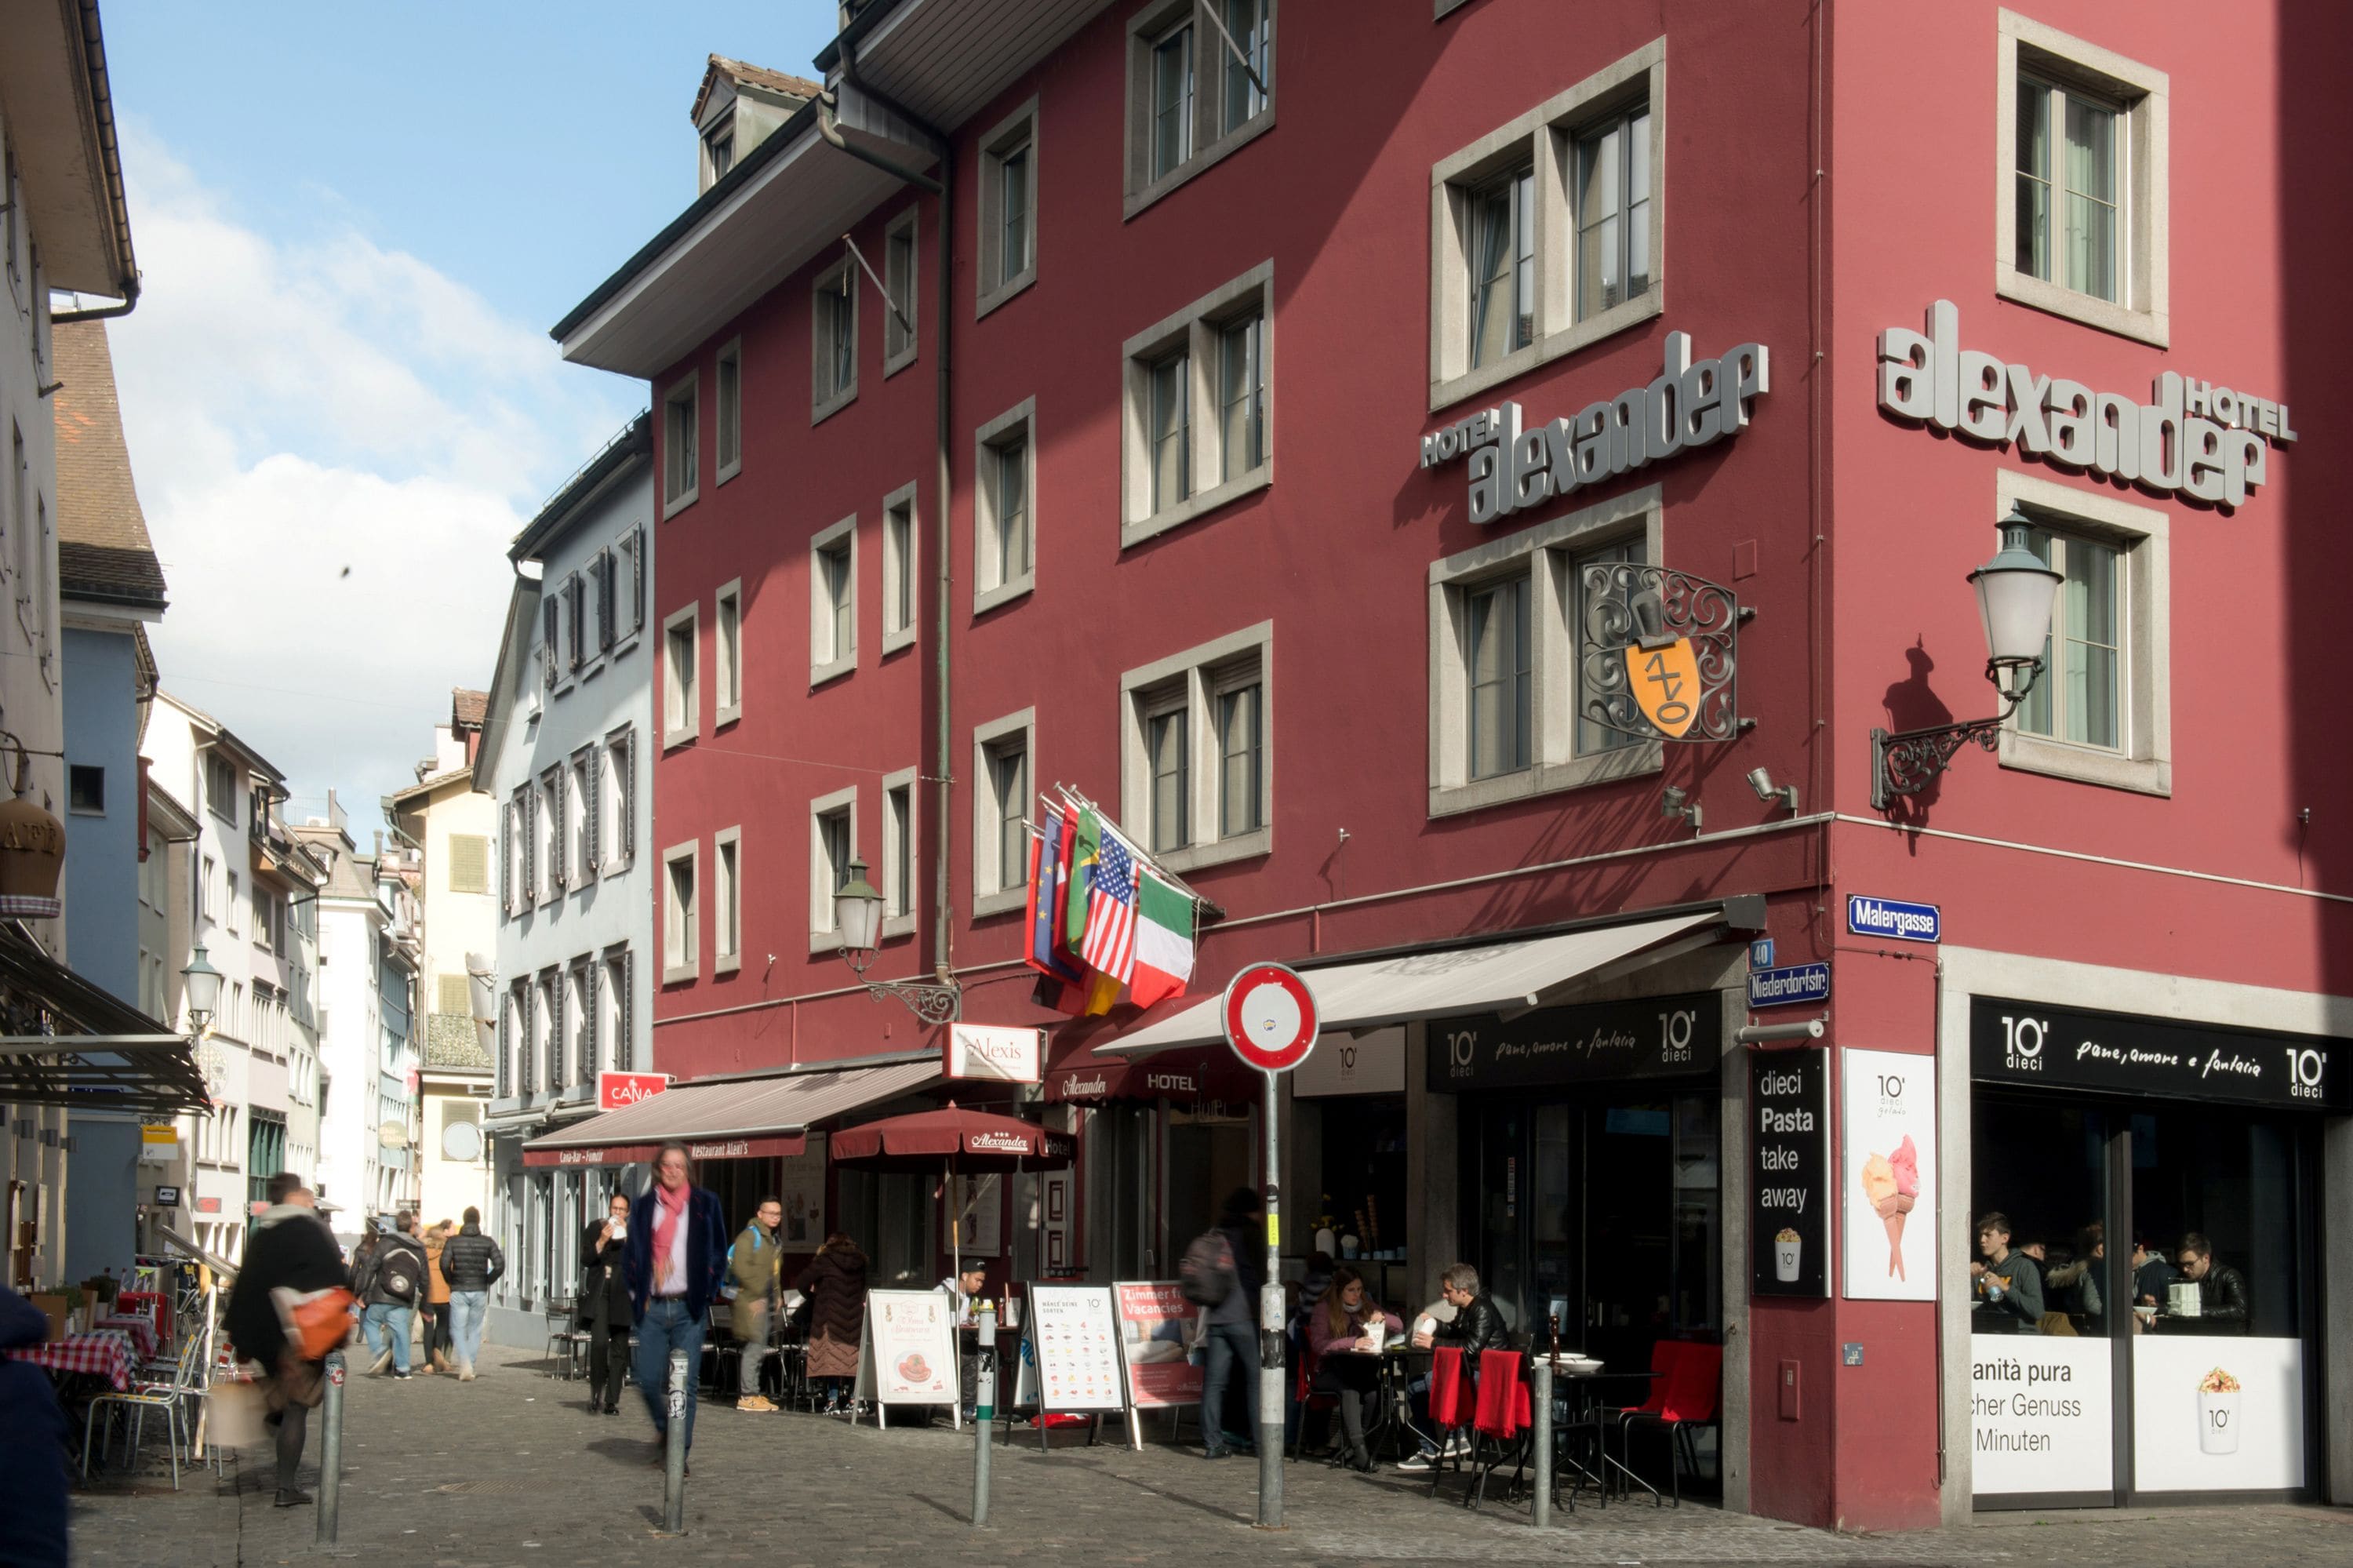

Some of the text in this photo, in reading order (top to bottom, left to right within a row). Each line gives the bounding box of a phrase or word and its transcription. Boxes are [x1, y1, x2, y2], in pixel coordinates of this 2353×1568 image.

[2184, 376, 2298, 442] HOTEL
[1420, 408, 1500, 469] HOTEL
[1856, 900, 1934, 935] Malergasse
[1754, 944, 1768, 965] 40
[1752, 969, 1826, 999] Niederdorfstr.
[965, 1035, 1021, 1062] Alexis
[1661, 1046, 1693, 1063] dieci
[1450, 1064, 1474, 1078] dieci
[2006, 1053, 2042, 1071] dieci
[1062, 1073, 1107, 1096] Alexander
[1147, 1074, 1197, 1091] HOTEL
[1761, 1068, 1802, 1096] dieci
[2291, 1082, 2323, 1099] dieci
[611, 1086, 653, 1101] CANA
[1881, 1097, 1903, 1106] dieci
[1761, 1108, 1814, 1133] Pasta
[692, 1142, 726, 1158] Restaurant
[972, 1133, 1029, 1148] Alexander
[1046, 1138, 1070, 1155] Hotel
[1761, 1144, 1798, 1170] take
[1761, 1188, 1807, 1214] away
[1124, 1288, 1168, 1301] Zimmer
[1126, 1302, 1184, 1315] Vacancies
[2028, 1363, 2072, 1386] pura
[2013, 1392, 2082, 1417] Genuss
[1976, 1428, 2051, 1452] Minuten
